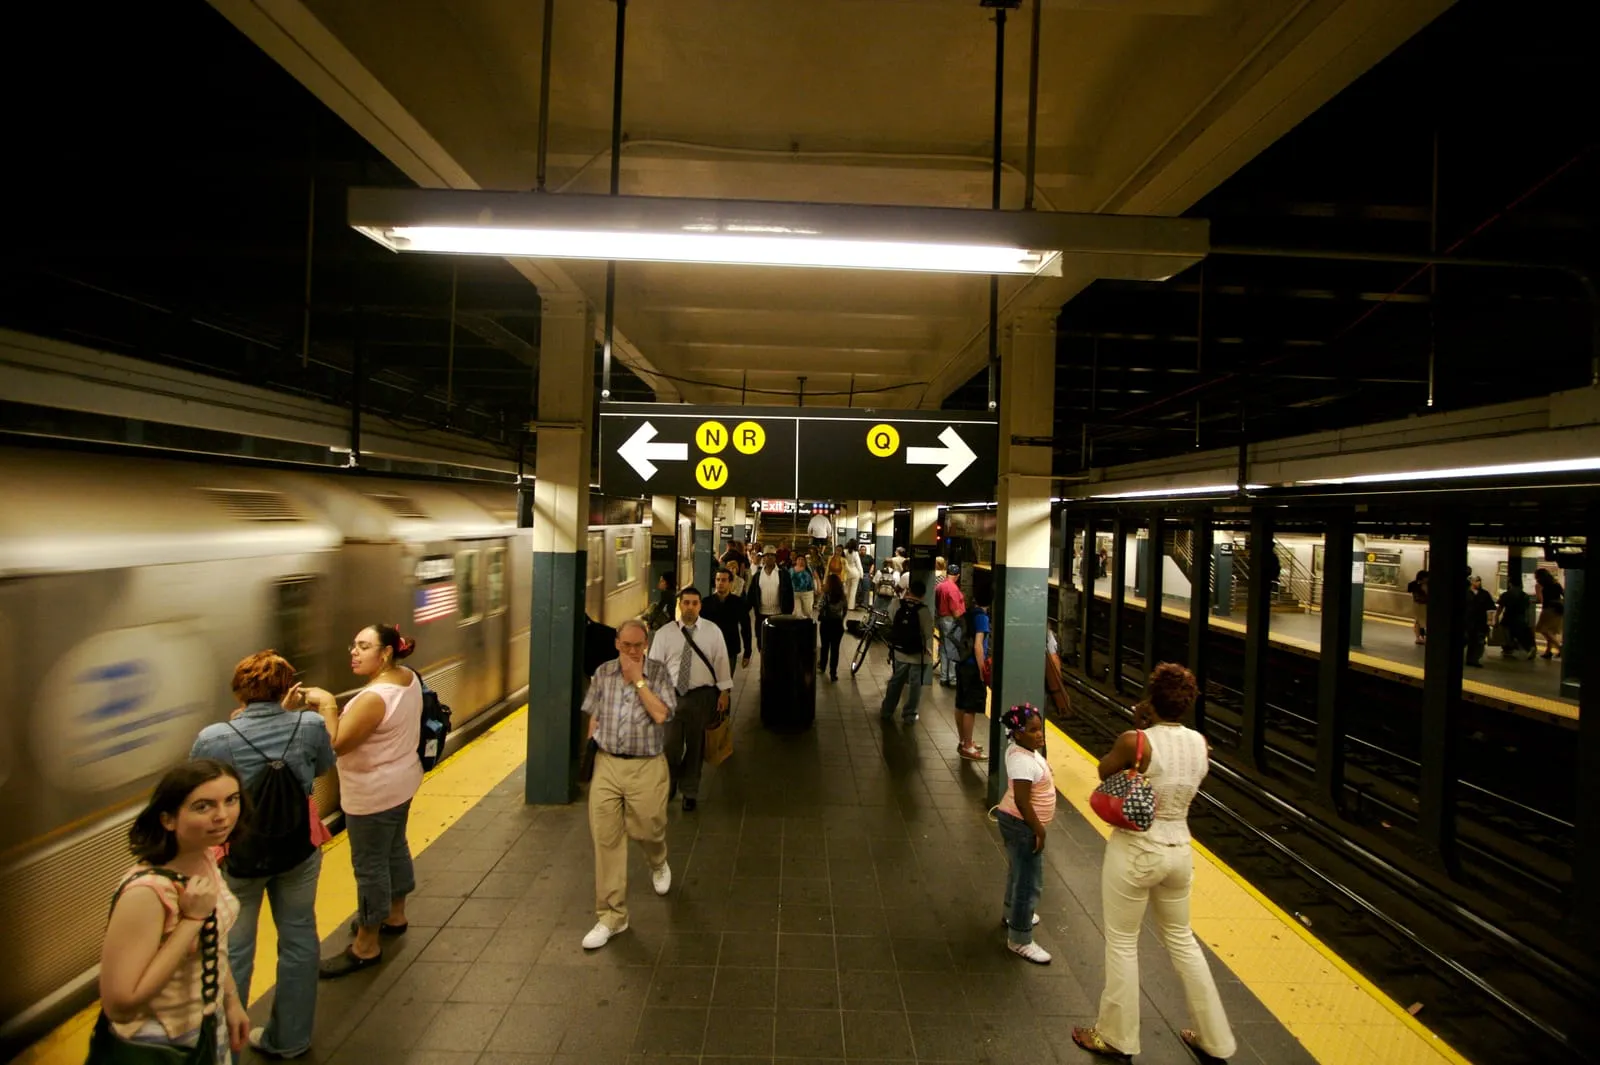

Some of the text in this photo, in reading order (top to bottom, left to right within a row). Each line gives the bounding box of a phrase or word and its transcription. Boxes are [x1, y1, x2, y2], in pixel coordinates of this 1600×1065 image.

[706, 429, 756, 446] N R
[874, 433, 891, 450] Q
[702, 465, 723, 481] W
[761, 500, 782, 511] Exit
